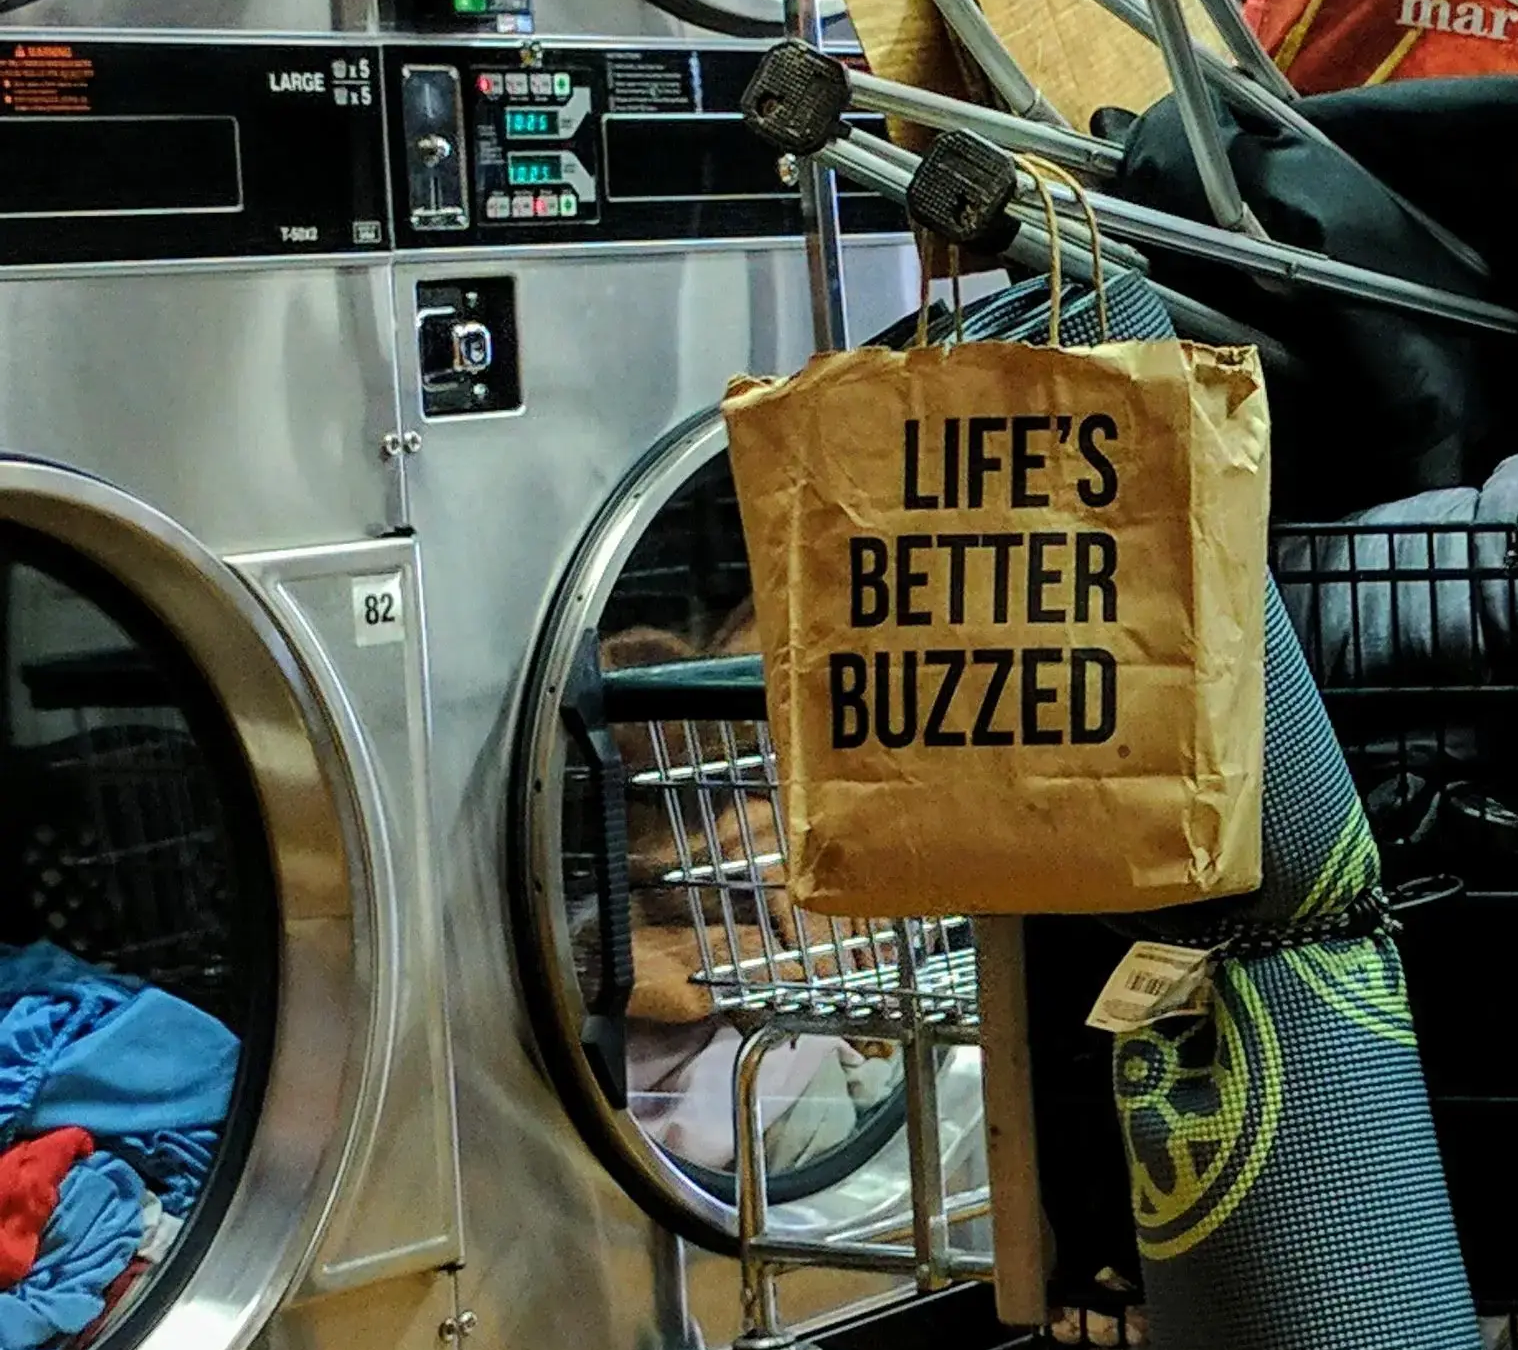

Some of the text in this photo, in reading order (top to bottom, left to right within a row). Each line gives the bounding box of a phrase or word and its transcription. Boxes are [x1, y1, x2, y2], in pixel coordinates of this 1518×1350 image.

[269, 72, 326, 92] LARGE
[364, 592, 396, 626] 82
[849, 531, 1118, 628] BETTER
[829, 647, 1117, 750] BUZZED
